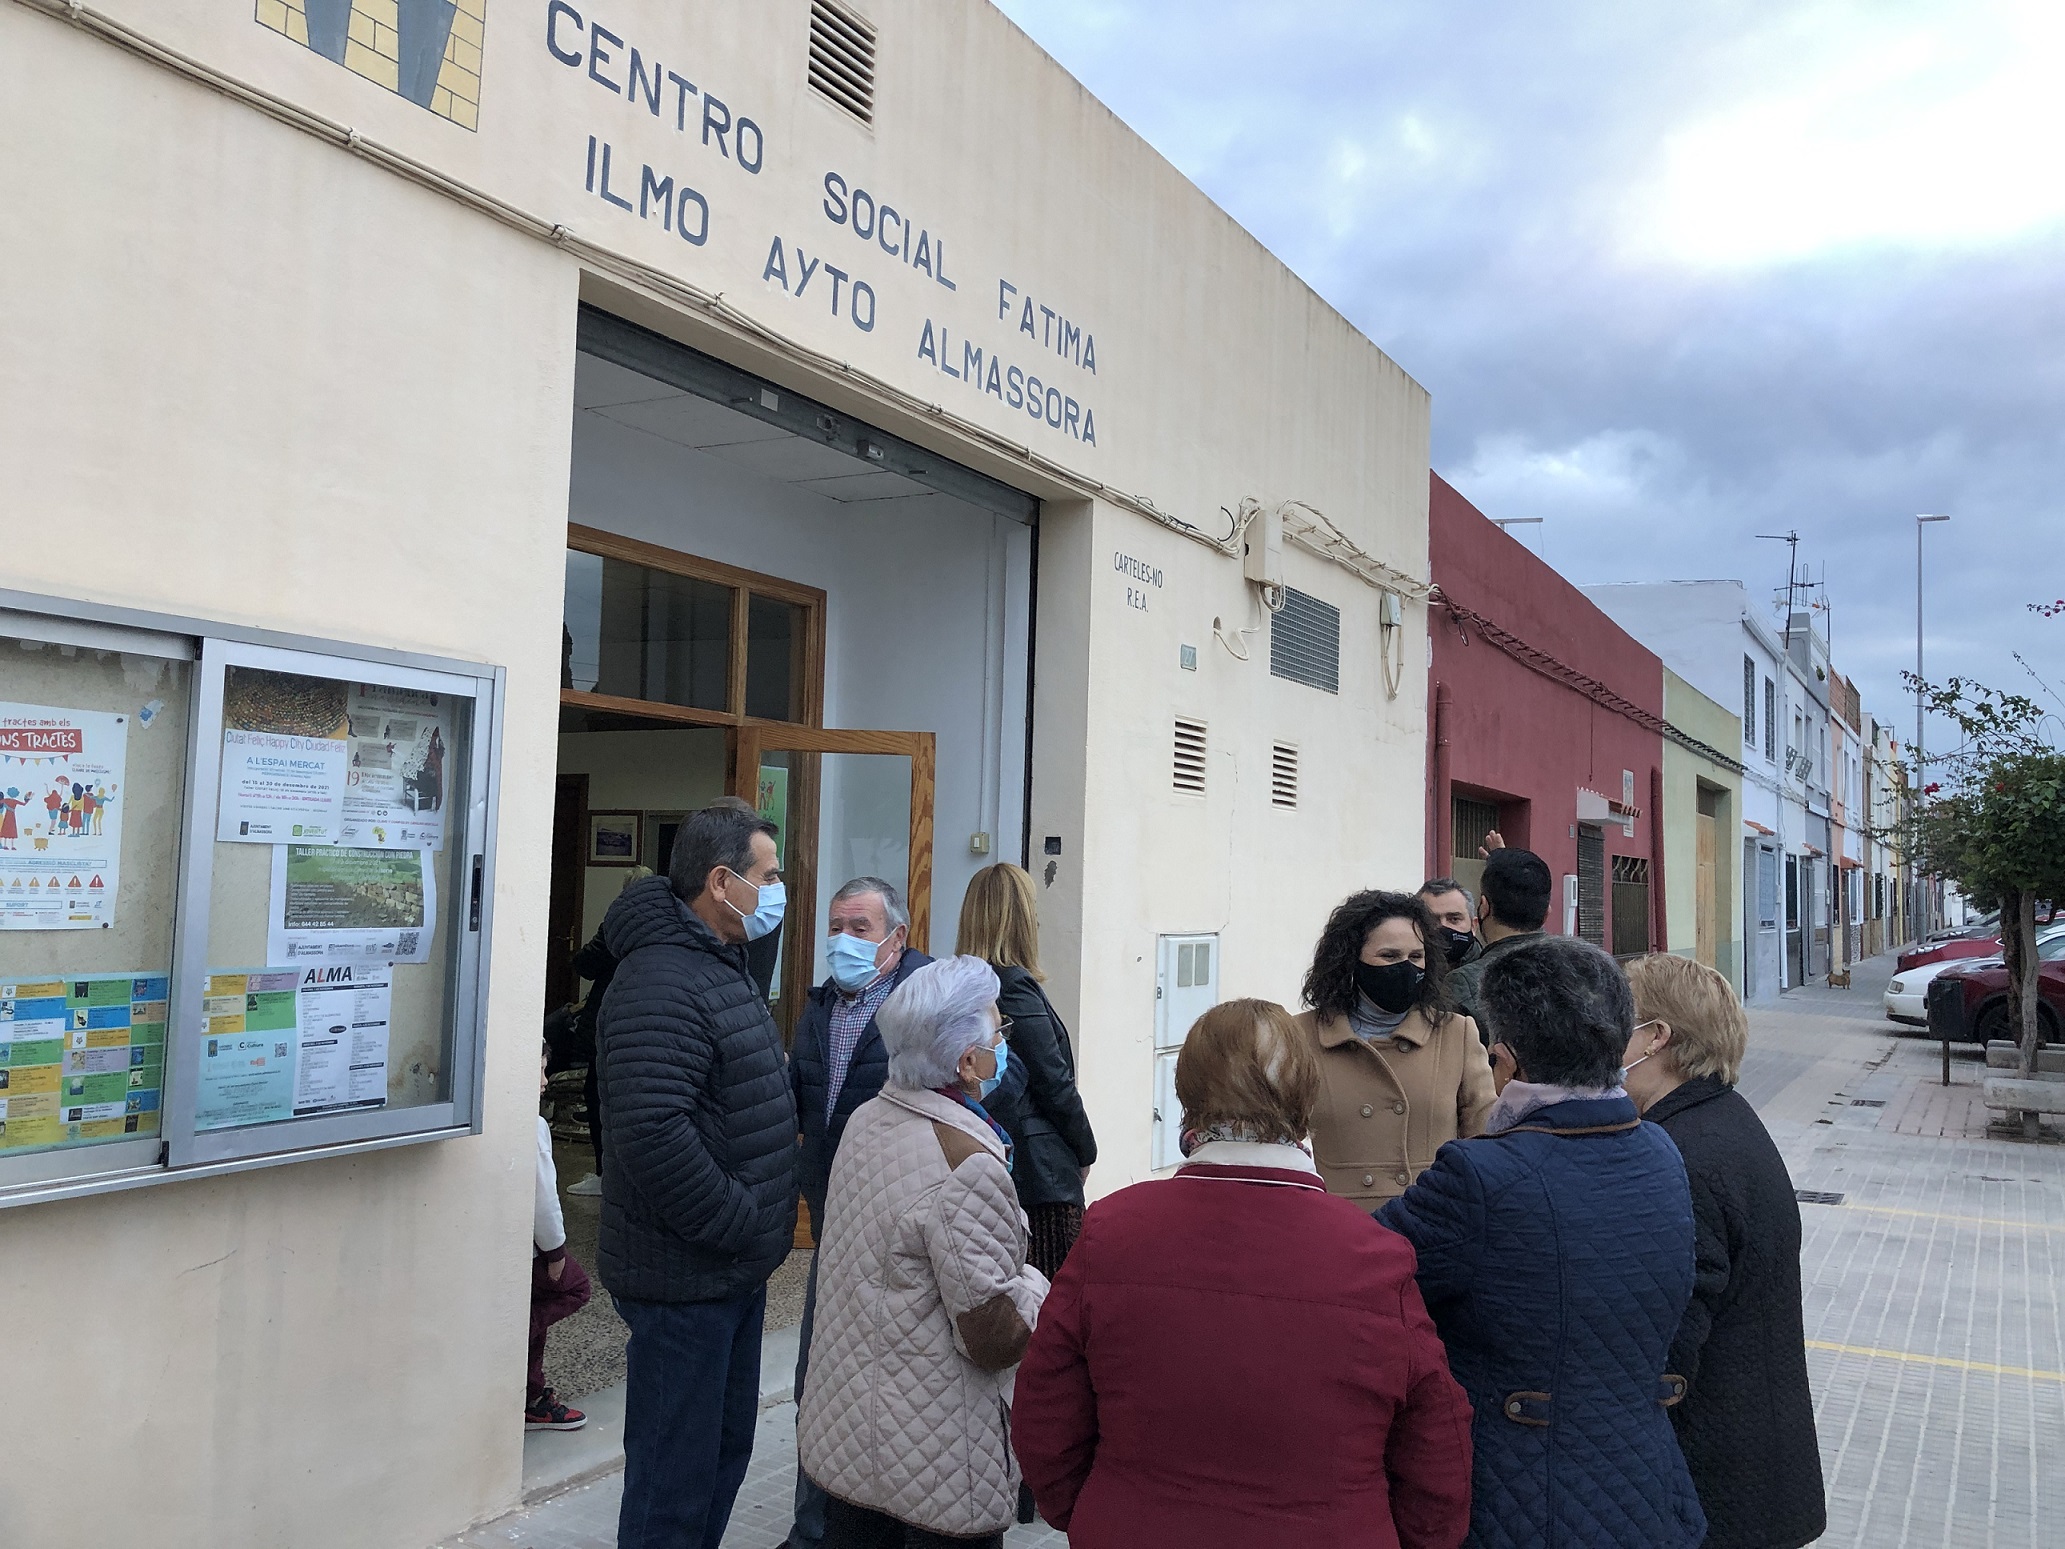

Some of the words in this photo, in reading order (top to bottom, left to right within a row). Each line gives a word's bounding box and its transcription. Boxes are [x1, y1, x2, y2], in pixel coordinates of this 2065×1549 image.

[546, 0, 764, 175] CENTRO
[823, 171, 957, 291] SOCIAL
[999, 278, 1097, 376] FATIMA
[585, 135, 709, 247] ILMO
[762, 235, 876, 333] AYTO
[917, 319, 1097, 448] ALMASSORA
[1114, 551, 1163, 588] CARTELES-NO
[1127, 587, 1148, 613] R.E.A.
[2, 718, 37, 727] tractes
[39, 718, 56, 727] amb
[59, 718, 71, 727] els
[0, 732, 20, 748] NS
[22, 731, 76, 748] TRACTES
[226, 731, 246, 745] Ciutat
[247, 734, 265, 747] Feliç
[266, 735, 289, 750] Happy
[290, 737, 305, 751] City
[305, 739, 330, 751] Ciudad
[330, 743, 346, 754] Feliz
[246, 756, 254, 765] A
[255, 757, 288, 767] L'ESPAI
[289, 760, 326, 770] MERCAT
[347, 771, 360, 787] 19
[296, 847, 315, 857] TALLER
[341, 849, 348, 858] DE
[303, 966, 353, 985] ALMA
